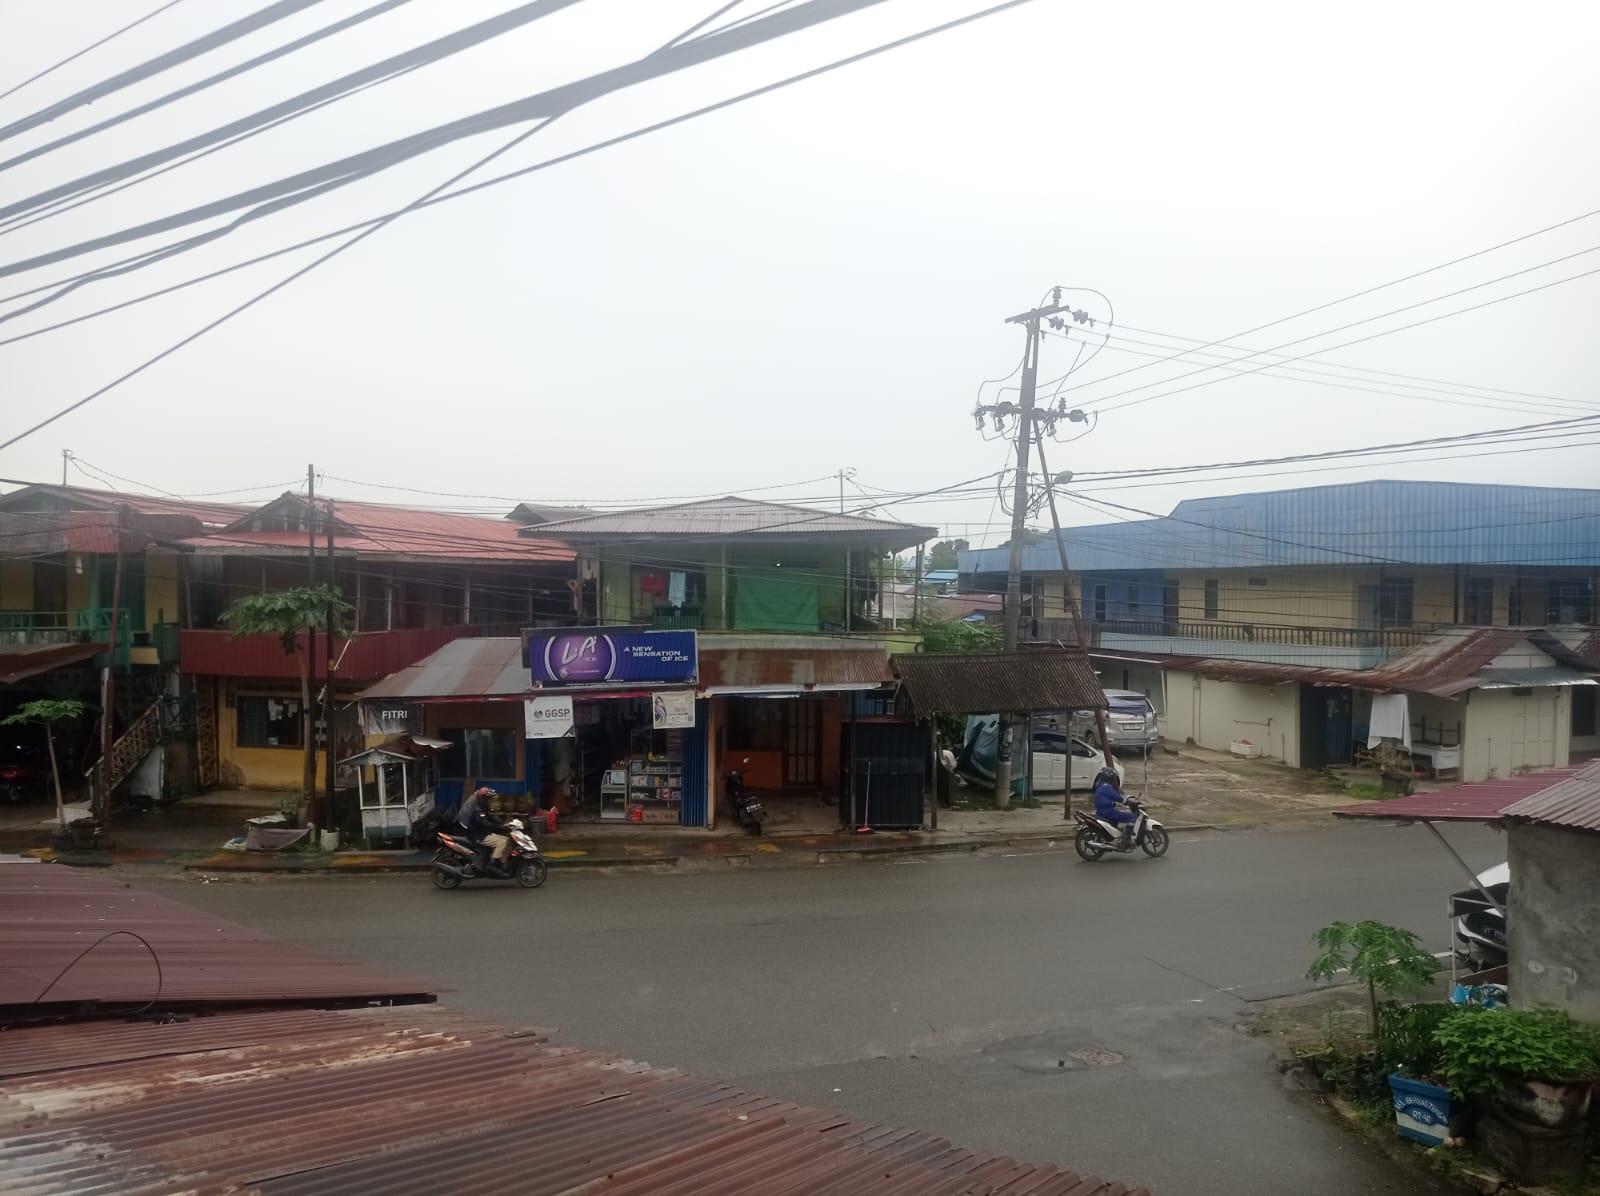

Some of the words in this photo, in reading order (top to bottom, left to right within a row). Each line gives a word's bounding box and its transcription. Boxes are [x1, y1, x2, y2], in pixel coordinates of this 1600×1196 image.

[382, 709, 408, 720] FITRI
[544, 708, 571, 719] GGSP
[1412, 1110, 1421, 1120] RT
